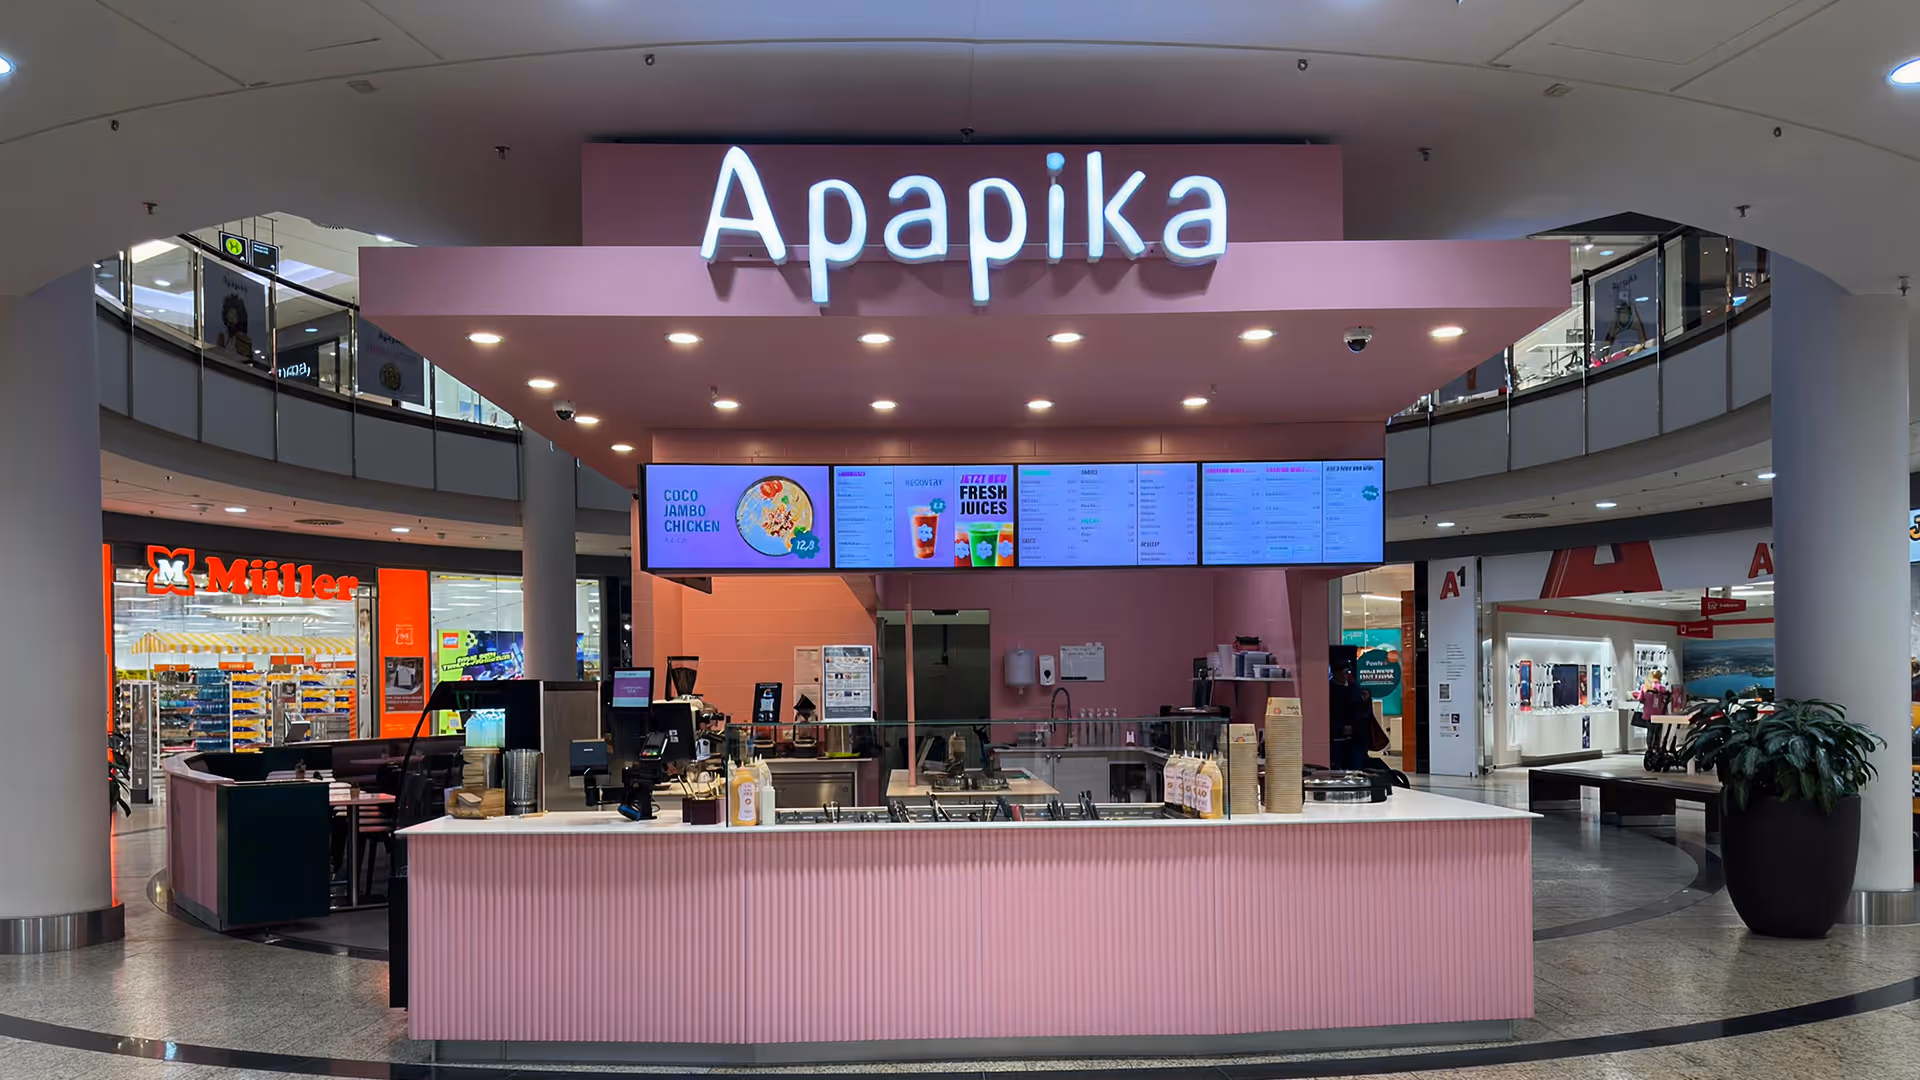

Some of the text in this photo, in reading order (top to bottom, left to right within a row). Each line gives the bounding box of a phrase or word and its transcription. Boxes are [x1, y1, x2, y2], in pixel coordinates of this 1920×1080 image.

[700, 146, 1228, 306] Apapika
[960, 474, 987, 484] JETZT
[663, 489, 698, 502] COCO
[959, 485, 1008, 500] FRESH
[663, 504, 706, 517] JAMBO
[959, 501, 1008, 515] JUICES
[663, 520, 720, 533] CHICKEN
[1747, 542, 1774, 579] A
[157, 559, 185, 583] M
[205, 556, 359, 601] Müller
[1440, 566, 1466, 600] A1
